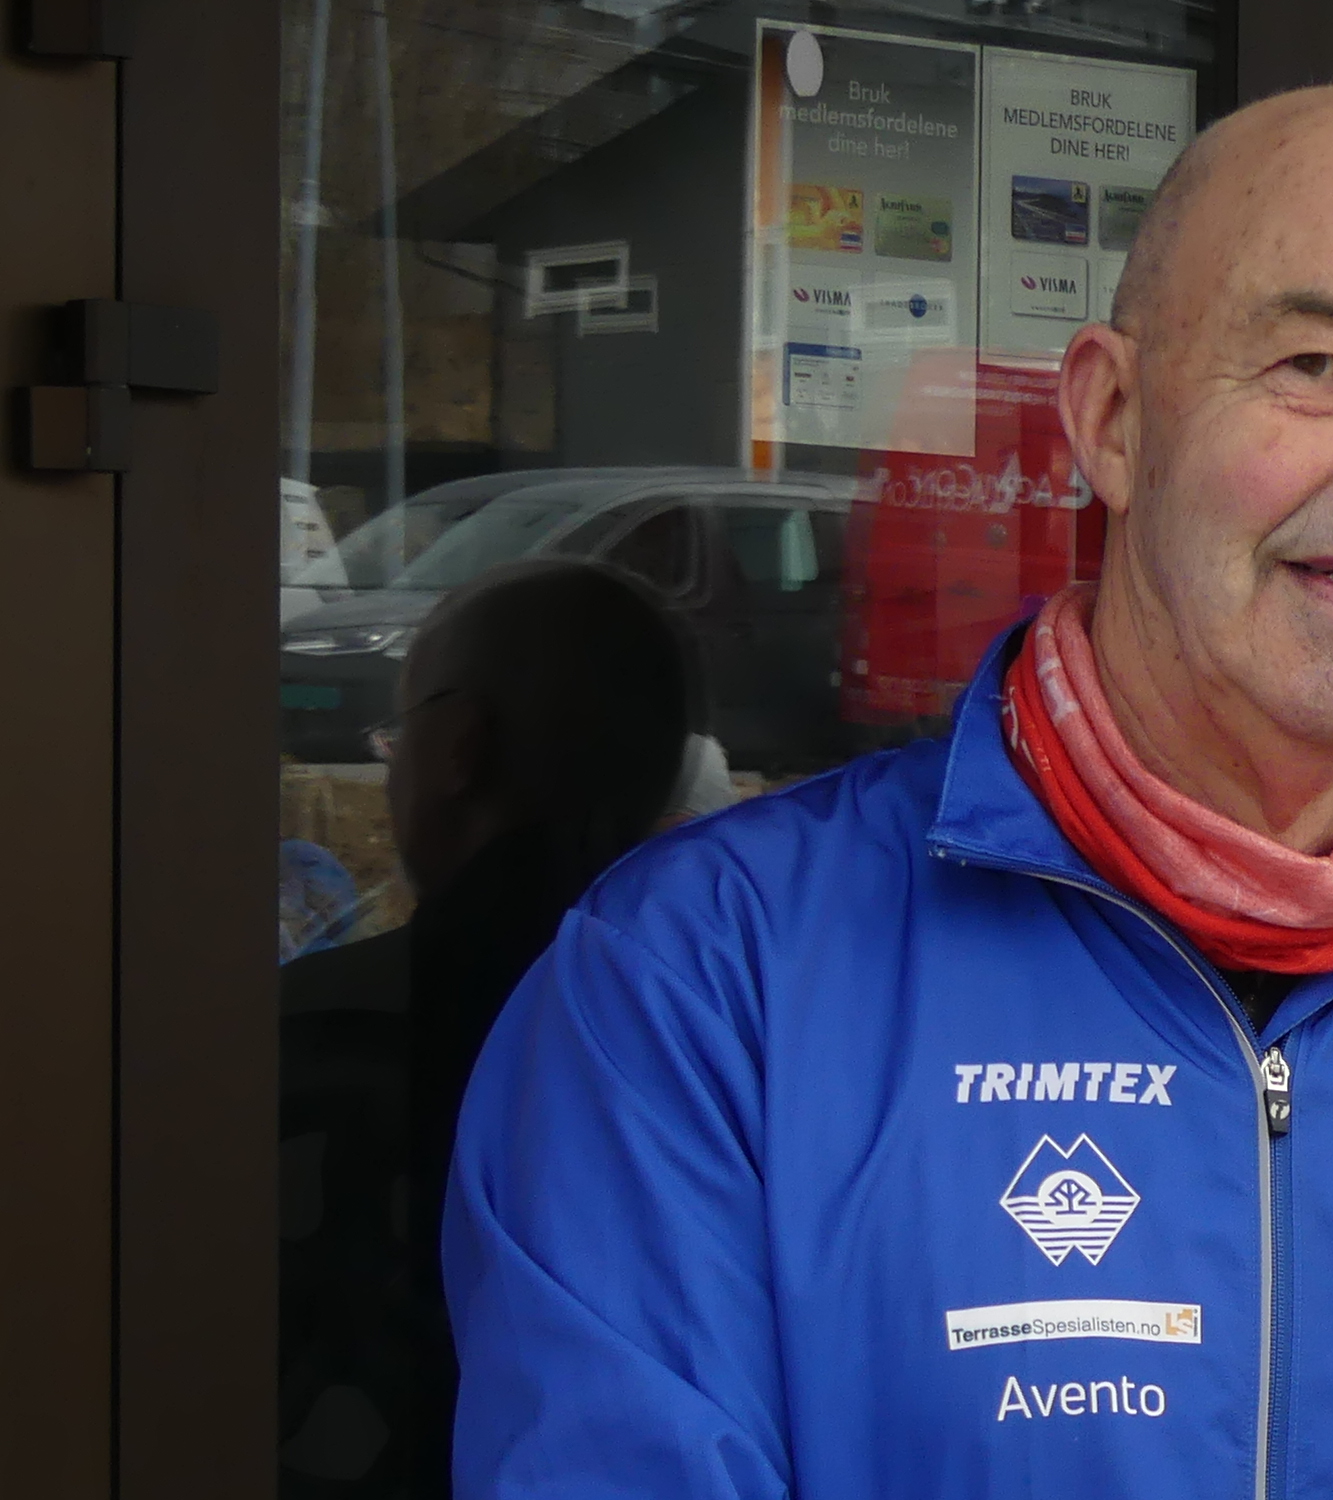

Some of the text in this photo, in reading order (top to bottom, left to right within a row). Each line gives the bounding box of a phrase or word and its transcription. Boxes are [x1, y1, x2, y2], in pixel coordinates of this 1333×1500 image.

[849, 80, 891, 104] Bruk
[1070, 88, 1112, 110] BRUK
[779, 103, 958, 138] medlemsfordelene
[1003, 107, 1177, 142] MEDLEMSFORDELENE
[828, 132, 868, 156] dine
[1050, 137, 1130, 161] DINE HER!
[813, 288, 851, 306] VISMA
[1039, 276, 1077, 295] VISMA
[954, 1062, 1177, 1106] TRIMTEX
[951, 1315, 1162, 1346] TerrasseSpesialisten.no
[996, 1374, 1167, 1422] Avento
